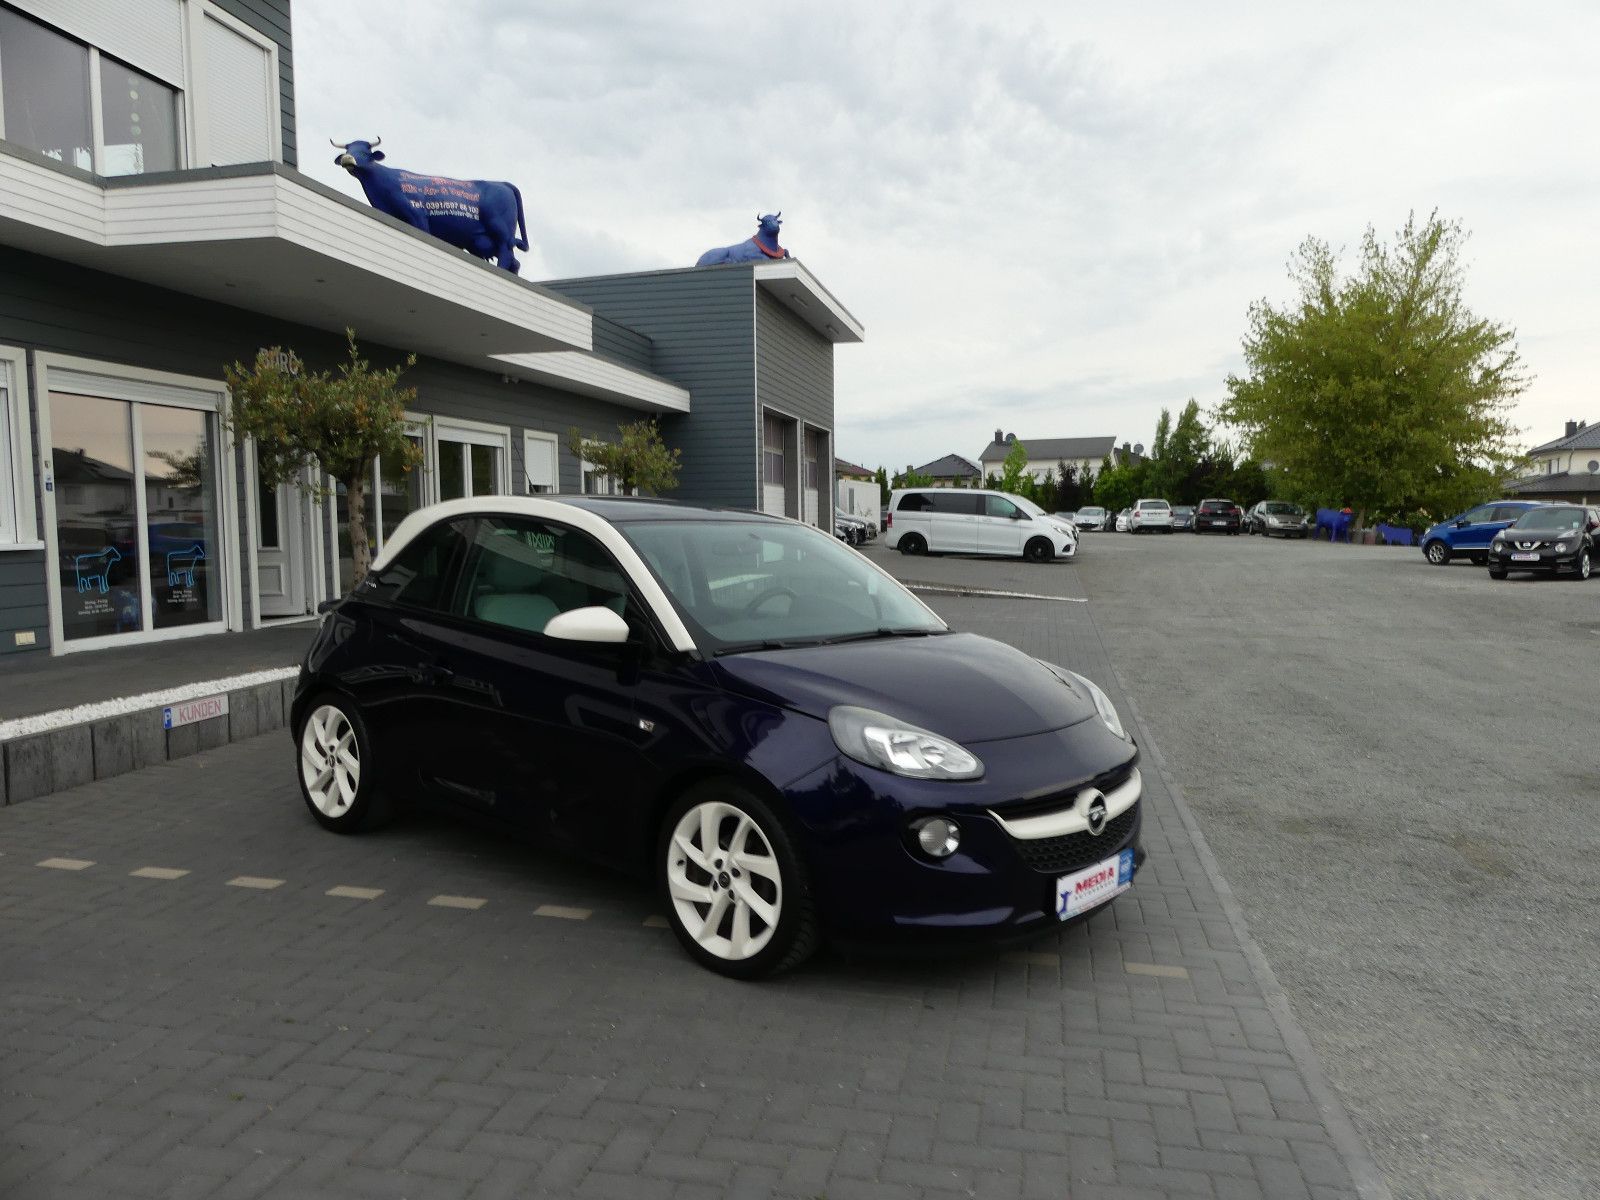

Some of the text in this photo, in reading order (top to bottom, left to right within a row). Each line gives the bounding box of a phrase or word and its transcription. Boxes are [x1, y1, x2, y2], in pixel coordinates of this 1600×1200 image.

[410, 200, 424, 209] Tel.
[178, 699, 222, 721] KUNDEN
[1075, 867, 1114, 894] MEDIA
